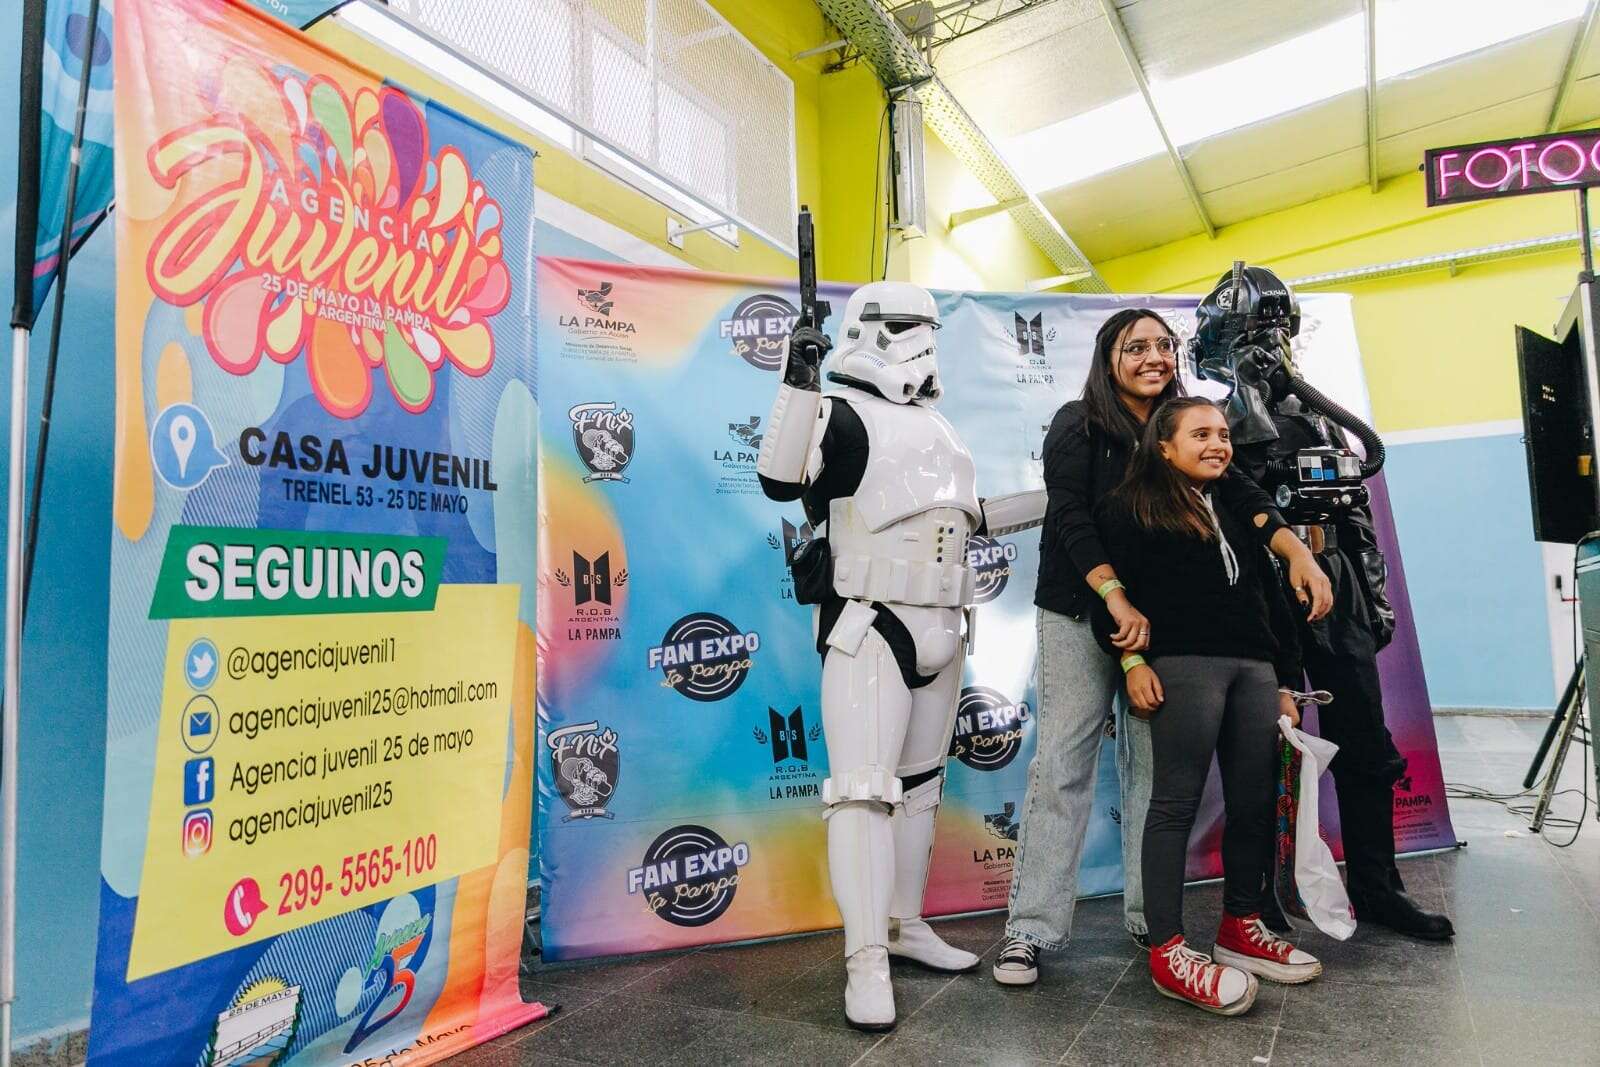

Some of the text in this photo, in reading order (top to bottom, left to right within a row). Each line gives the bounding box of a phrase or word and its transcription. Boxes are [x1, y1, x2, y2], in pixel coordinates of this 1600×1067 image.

[1439, 138, 1600, 200] FOTO
[148, 121, 472, 319] Juvenil
[267, 177, 431, 255] AGENCIA
[260, 272, 433, 332] 25 DE MAYO LA PAMPA
[319, 305, 388, 334] ARGENTINA
[559, 315, 636, 333] LA PAMPA
[720, 318, 759, 338] FAN
[239, 426, 499, 492] CASA JUVENIL
[713, 450, 733, 462] LA
[283, 478, 351, 507] TRENEL
[356, 488, 374, 508] 53
[387, 490, 404, 510] 25
[408, 492, 427, 512] DE
[430, 494, 468, 515] MAYO
[967, 543, 1017, 568] EXPO
[184, 543, 427, 602] SEGUINOS
[781, 588, 793, 600] LA
[568, 628, 621, 640] LA PAMPA
[227, 637, 396, 682] @agenciajuvenil1
[649, 632, 760, 669] FAN EXPO
[688, 659, 752, 682] Pampa
[228, 680, 499, 740] agenciajuvenil25@hotmail.com
[977, 702, 1030, 731] EXPO
[970, 728, 1026, 752] Pampa
[229, 728, 475, 796] Agencia juvenil 25 de mayo
[769, 772, 817, 781] ARGENTINA
[769, 783, 820, 800] LA PAMPA
[1395, 796, 1432, 808] PAMPA
[228, 781, 394, 846] agenciajuvenil25
[340, 833, 437, 897] 5565-100
[629, 843, 748, 894] FAN EXPO
[974, 850, 993, 863] LA
[672, 872, 743, 906] Pampa
[260, 989, 292, 1004] MAYO
